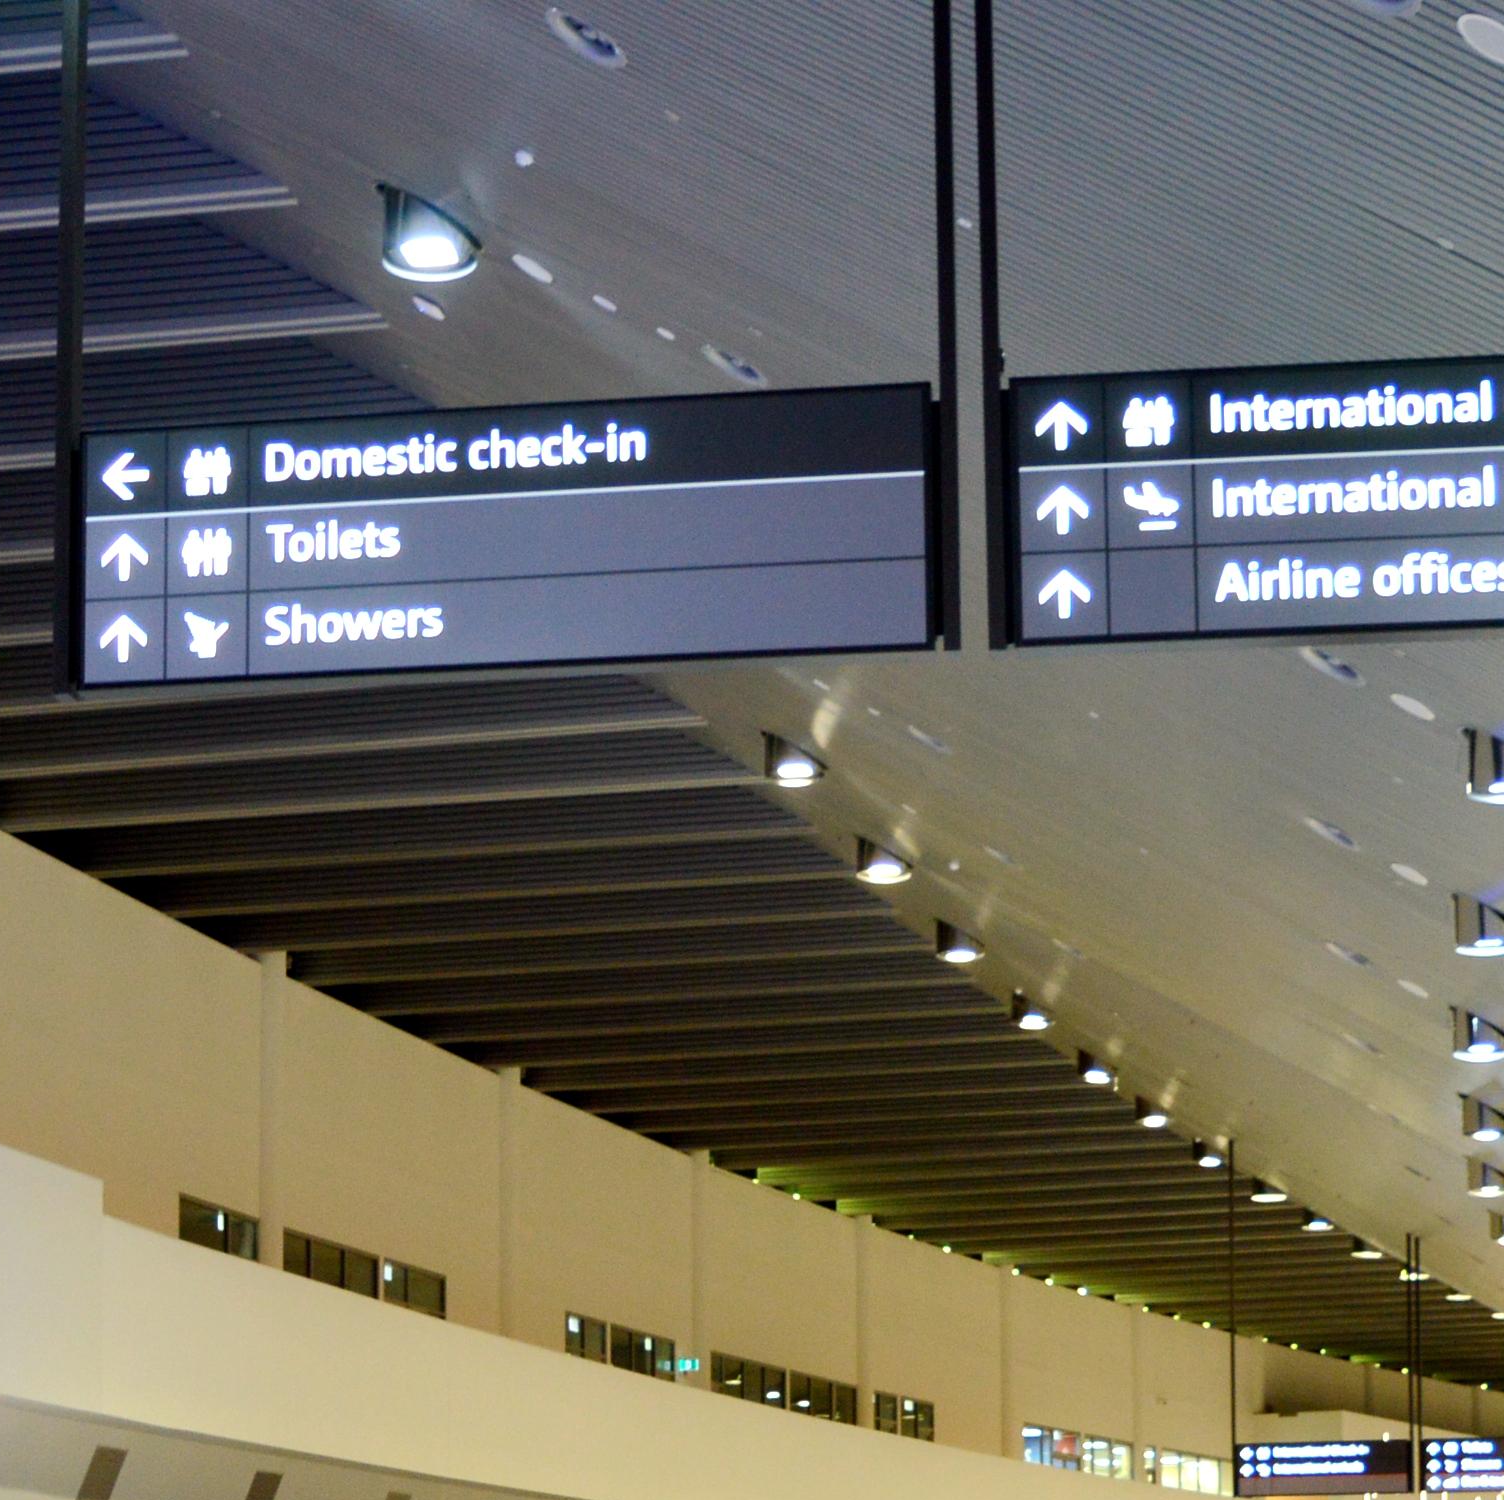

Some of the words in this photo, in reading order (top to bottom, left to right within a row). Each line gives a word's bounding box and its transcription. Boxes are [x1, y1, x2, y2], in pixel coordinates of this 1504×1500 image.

[1209, 382, 1494, 434] International
[264, 430, 457, 484] Domestic
[468, 423, 647, 472] check-in
[1211, 467, 1495, 518] International
[265, 519, 401, 563] Toilets
[1215, 557, 1361, 603] Airline
[264, 603, 443, 646] Showers
